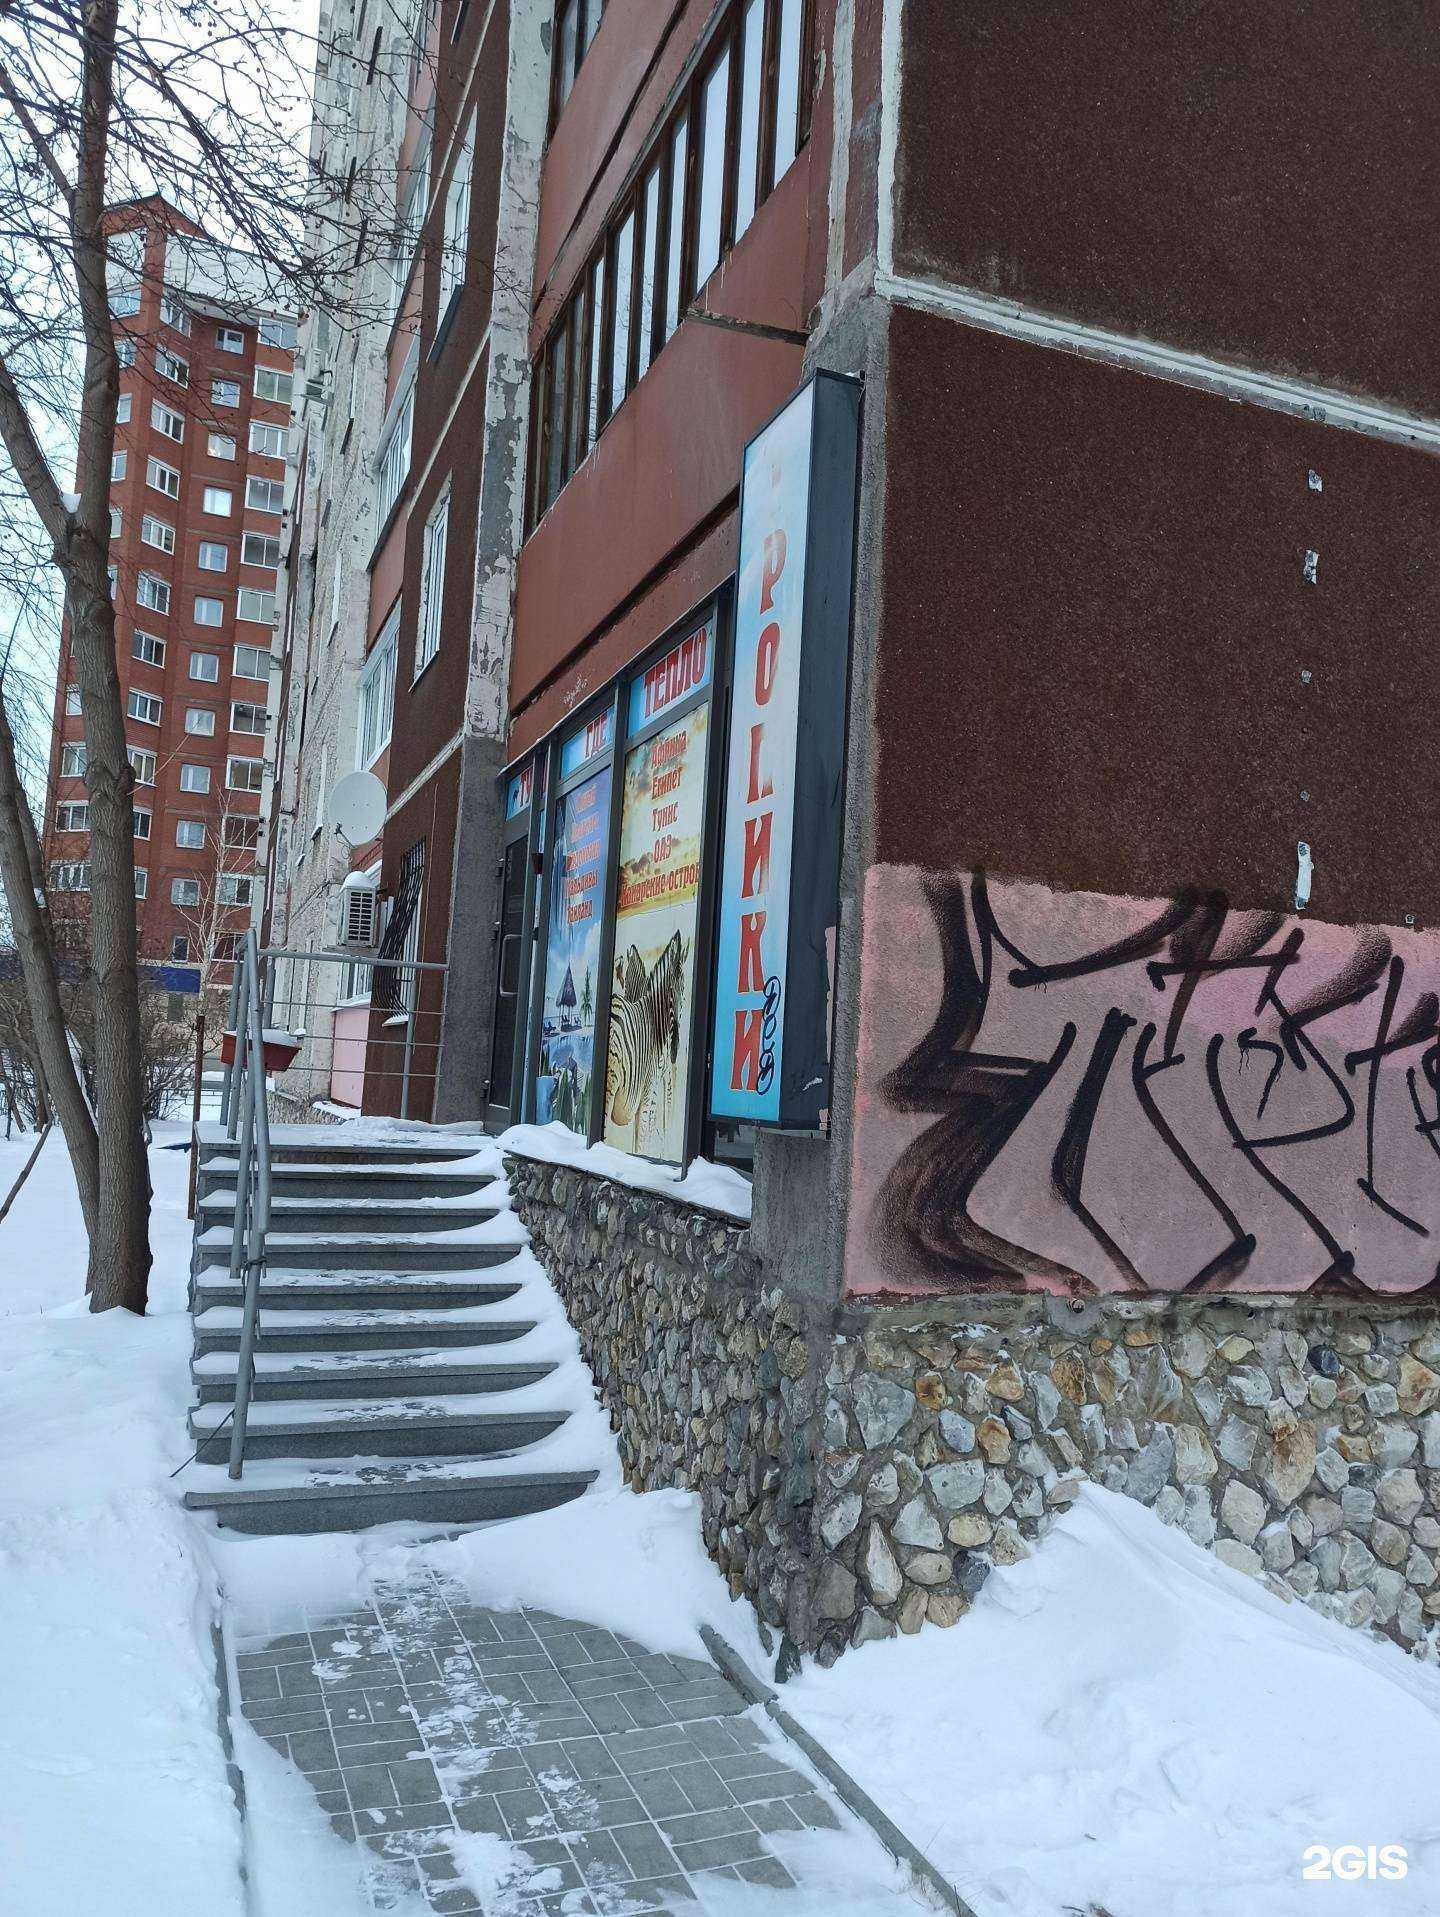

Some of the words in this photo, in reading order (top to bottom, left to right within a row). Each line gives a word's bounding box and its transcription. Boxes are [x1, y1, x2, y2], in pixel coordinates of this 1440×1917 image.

[643, 627, 708, 719] ТЕПЛО
[651, 766, 683, 800] Египет
[652, 801, 679, 831] Тунис
